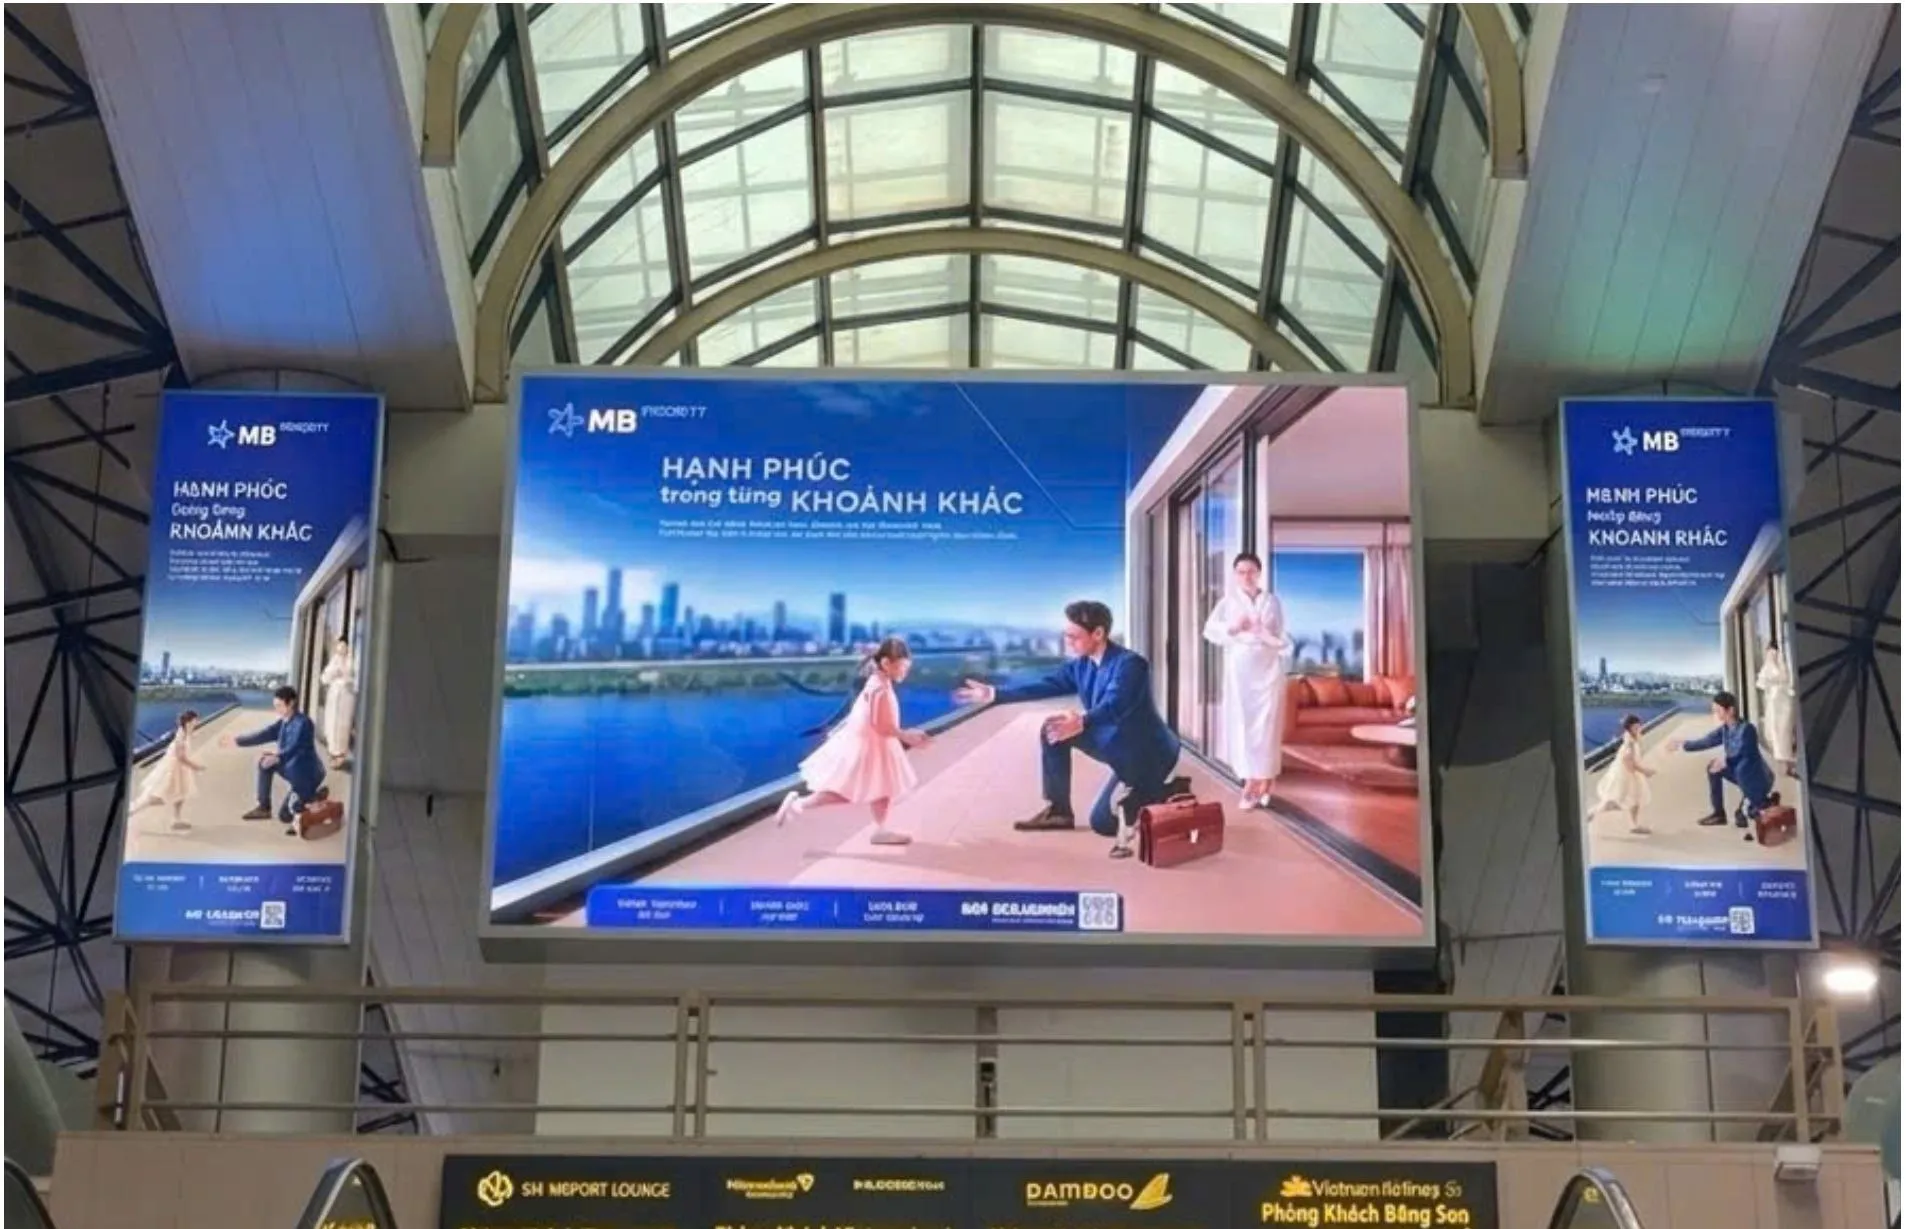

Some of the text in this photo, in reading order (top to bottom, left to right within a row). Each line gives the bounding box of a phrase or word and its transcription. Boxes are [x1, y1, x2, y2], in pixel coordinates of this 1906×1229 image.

[588, 408, 638, 434] MB
[237, 425, 277, 446] MB
[1642, 430, 1680, 452] MB
[662, 451, 851, 487] HẠNH PHÚC
[660, 485, 722, 508] trong
[611, 1181, 672, 1199] LOUNGE
